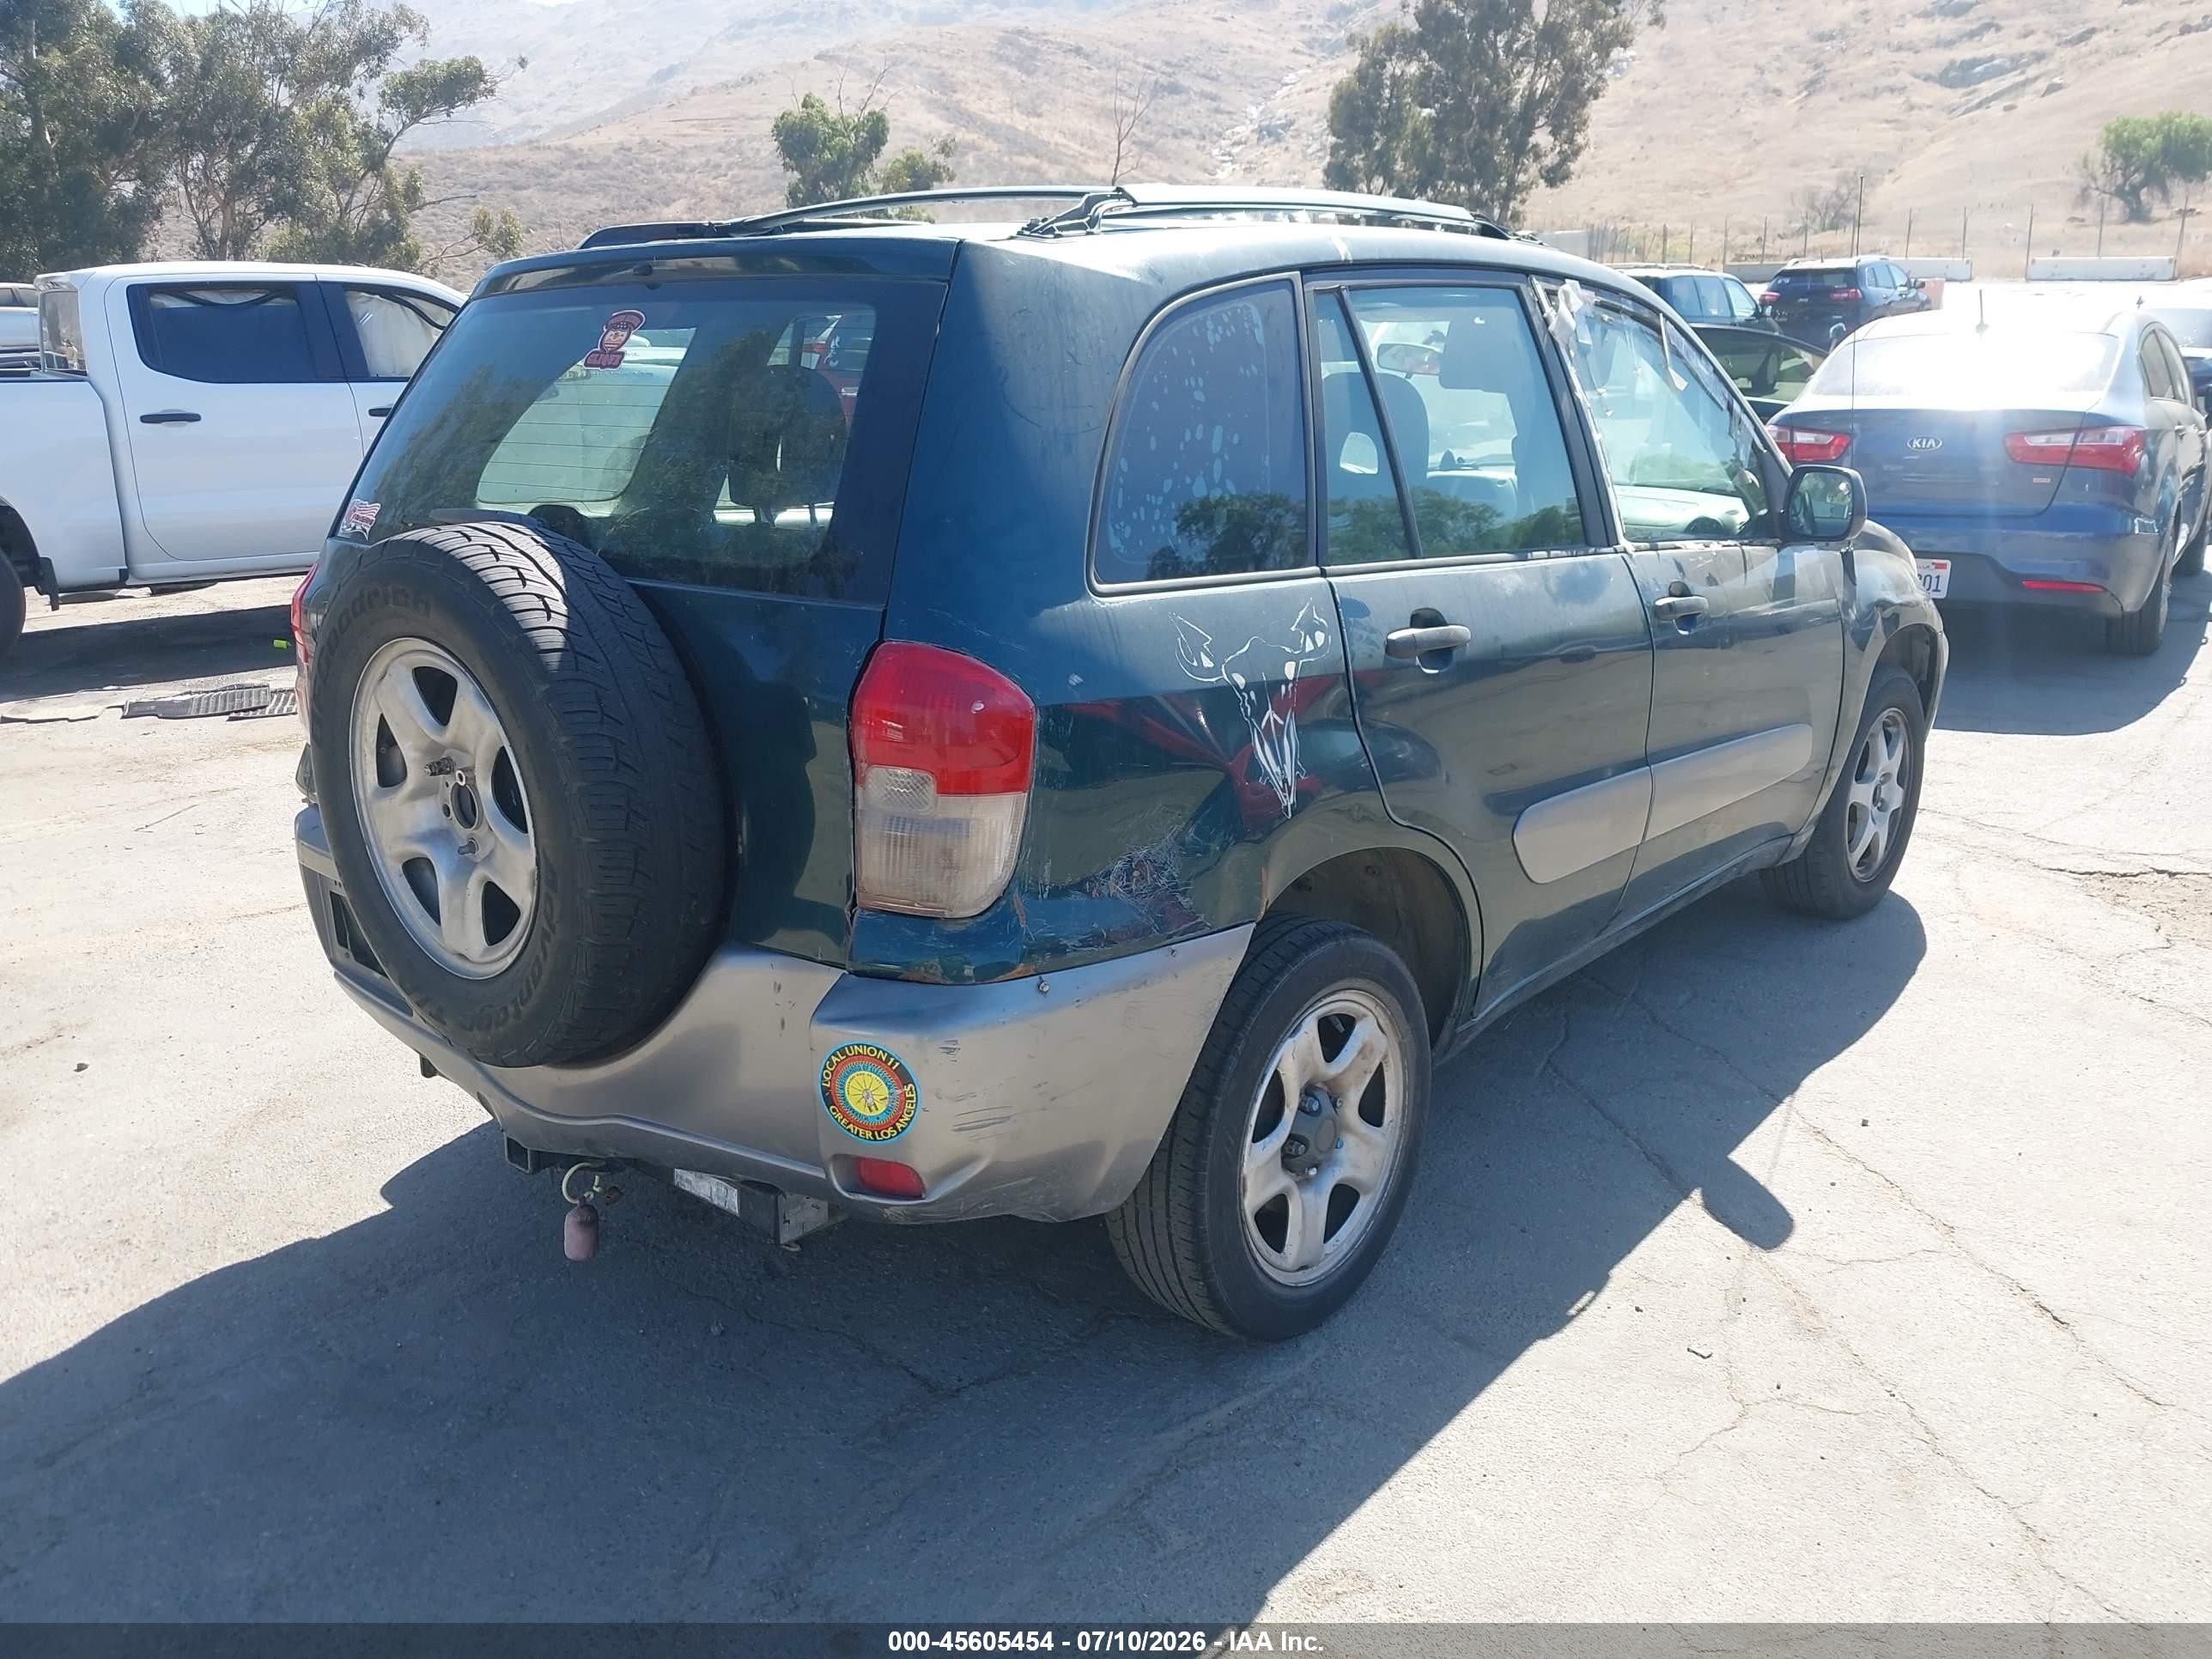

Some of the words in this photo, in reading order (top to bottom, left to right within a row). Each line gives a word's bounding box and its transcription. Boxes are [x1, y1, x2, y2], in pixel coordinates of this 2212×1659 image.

[1912, 438, 1936, 448] KIA
[822, 1051, 847, 1088] LOCAL
[844, 1045, 888, 1062] UNION
[887, 1055, 901, 1070] 11
[829, 1105, 875, 1140] GREATER
[874, 1127, 897, 1140] LOS
[895, 1083, 916, 1131] ANGELES
